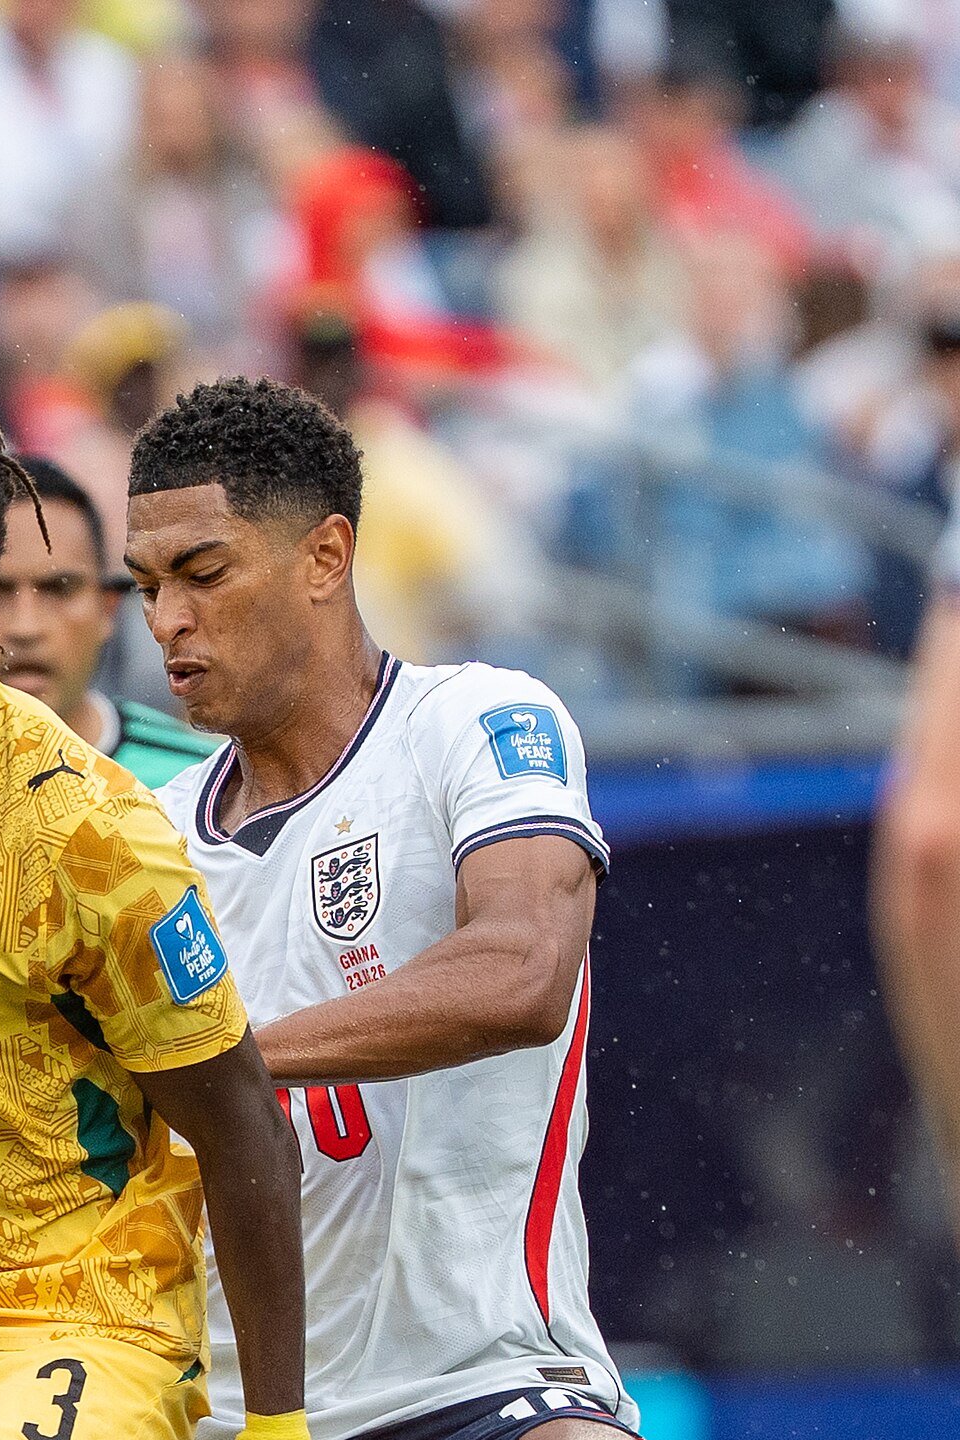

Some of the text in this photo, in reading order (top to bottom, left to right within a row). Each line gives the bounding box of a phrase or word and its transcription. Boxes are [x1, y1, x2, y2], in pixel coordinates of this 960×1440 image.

[516, 746, 554, 761] PEACE
[186, 945, 215, 978] PEACE
[198, 965, 216, 983] FIFA
